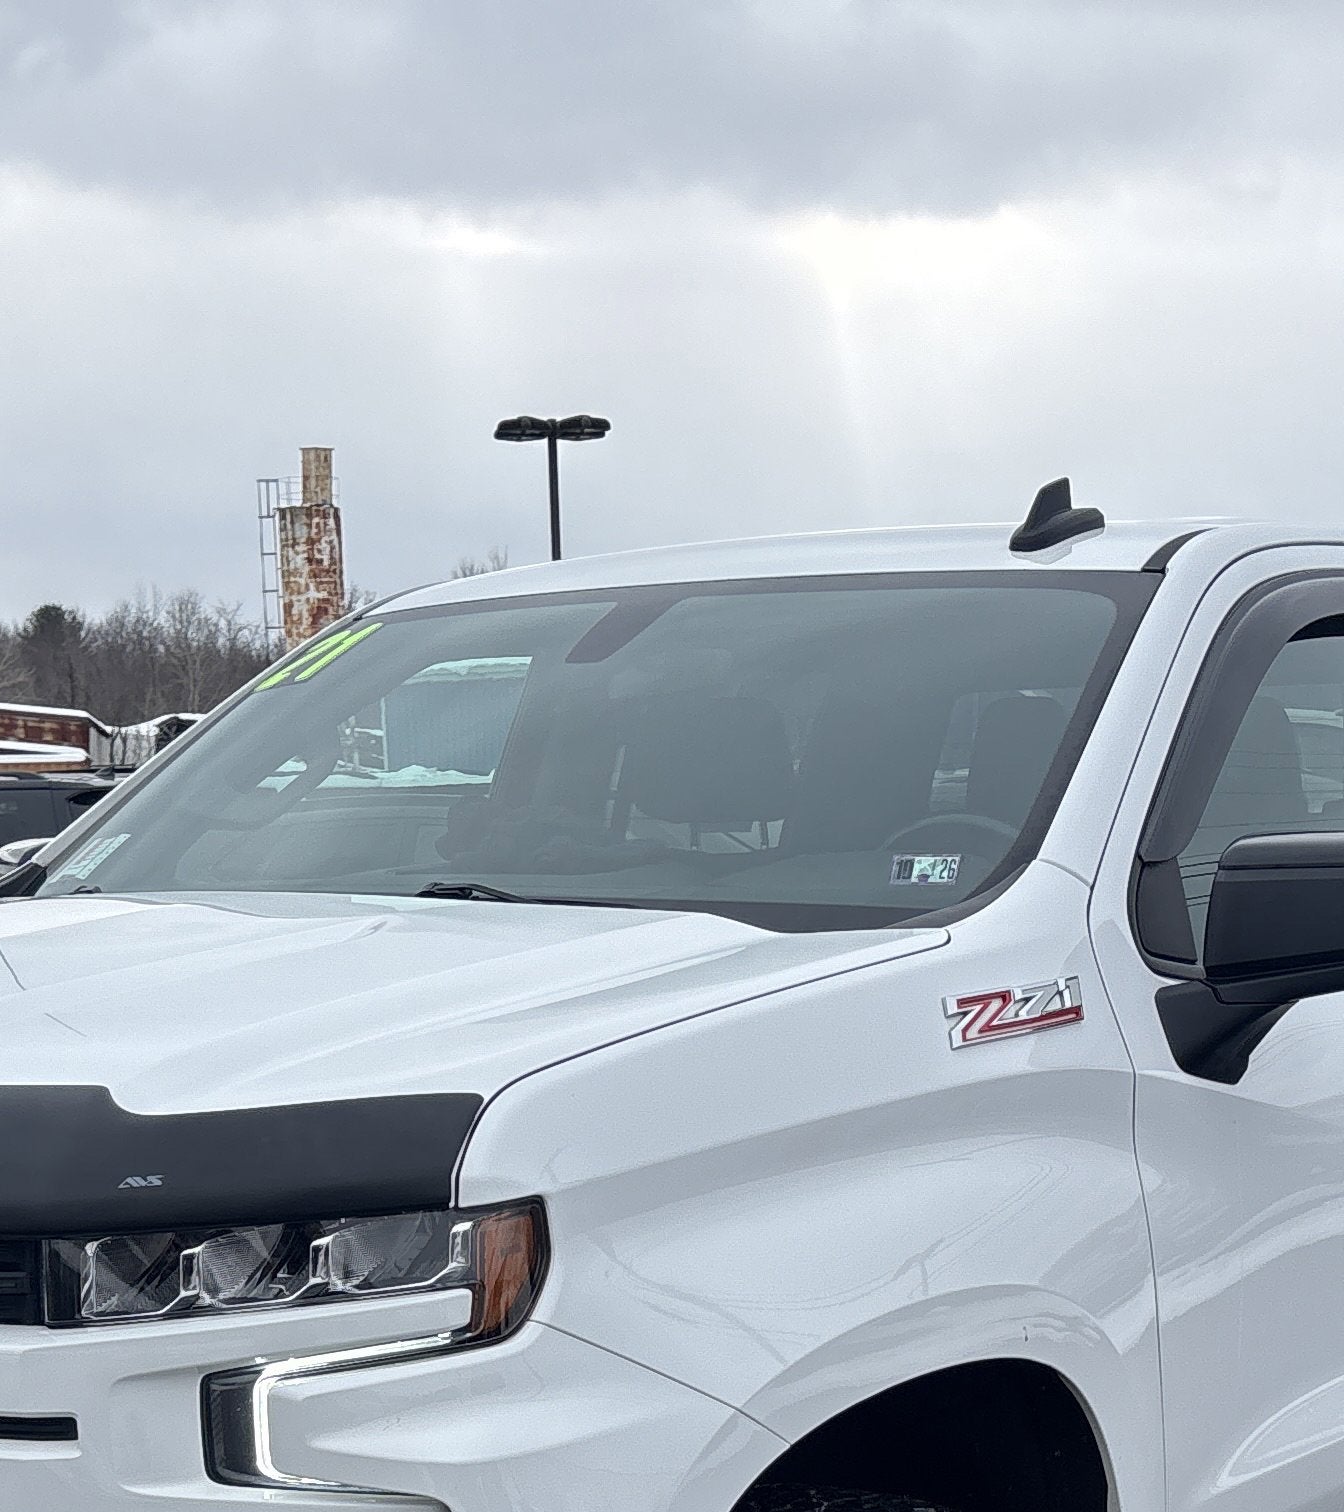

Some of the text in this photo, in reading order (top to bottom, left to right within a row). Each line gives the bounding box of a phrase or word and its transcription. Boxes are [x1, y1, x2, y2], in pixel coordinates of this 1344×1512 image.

[253, 622, 384, 692] 21
[895, 858, 957, 880] 10 26
[941, 975, 1084, 1050] Z71
